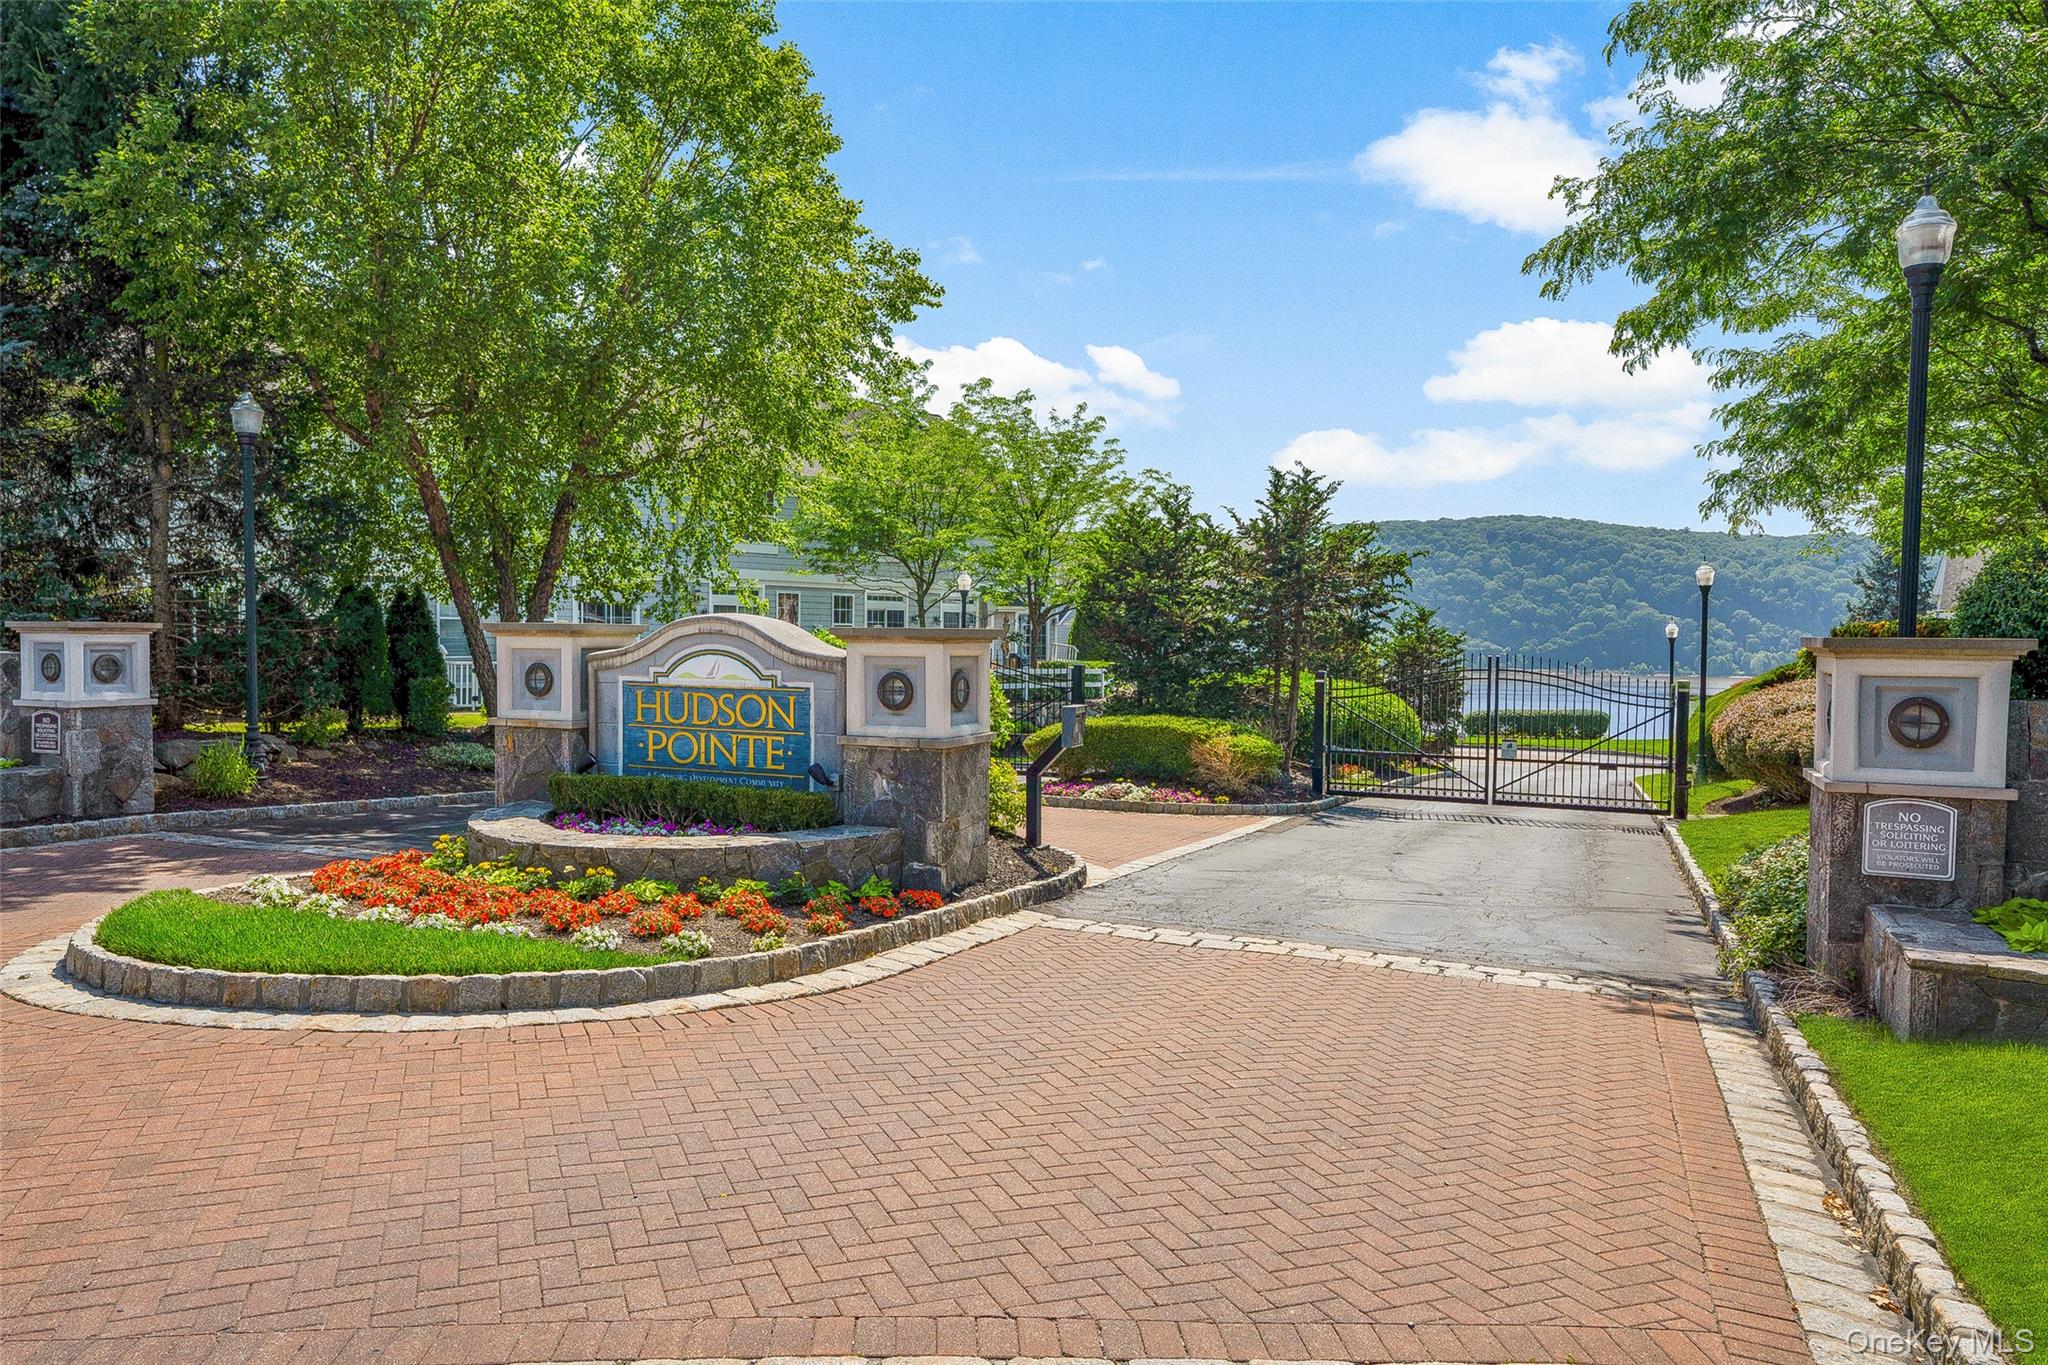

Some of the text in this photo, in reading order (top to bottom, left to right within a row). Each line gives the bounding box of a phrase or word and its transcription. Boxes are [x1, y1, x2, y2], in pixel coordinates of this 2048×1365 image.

[634, 688, 797, 730] HUDSON
[646, 729, 785, 770] POINTE
[739, 777, 785, 788] COMMUNITY
[1898, 811, 1921, 823] NO
[1874, 821, 1945, 834] TRESPASSING
[1880, 830, 1938, 842] SOLICITING
[1871, 839, 1946, 852] OR LOITERING
[1876, 853, 1918, 862] VIOLATORS
[1888, 861, 1940, 871] PROSECUTED
